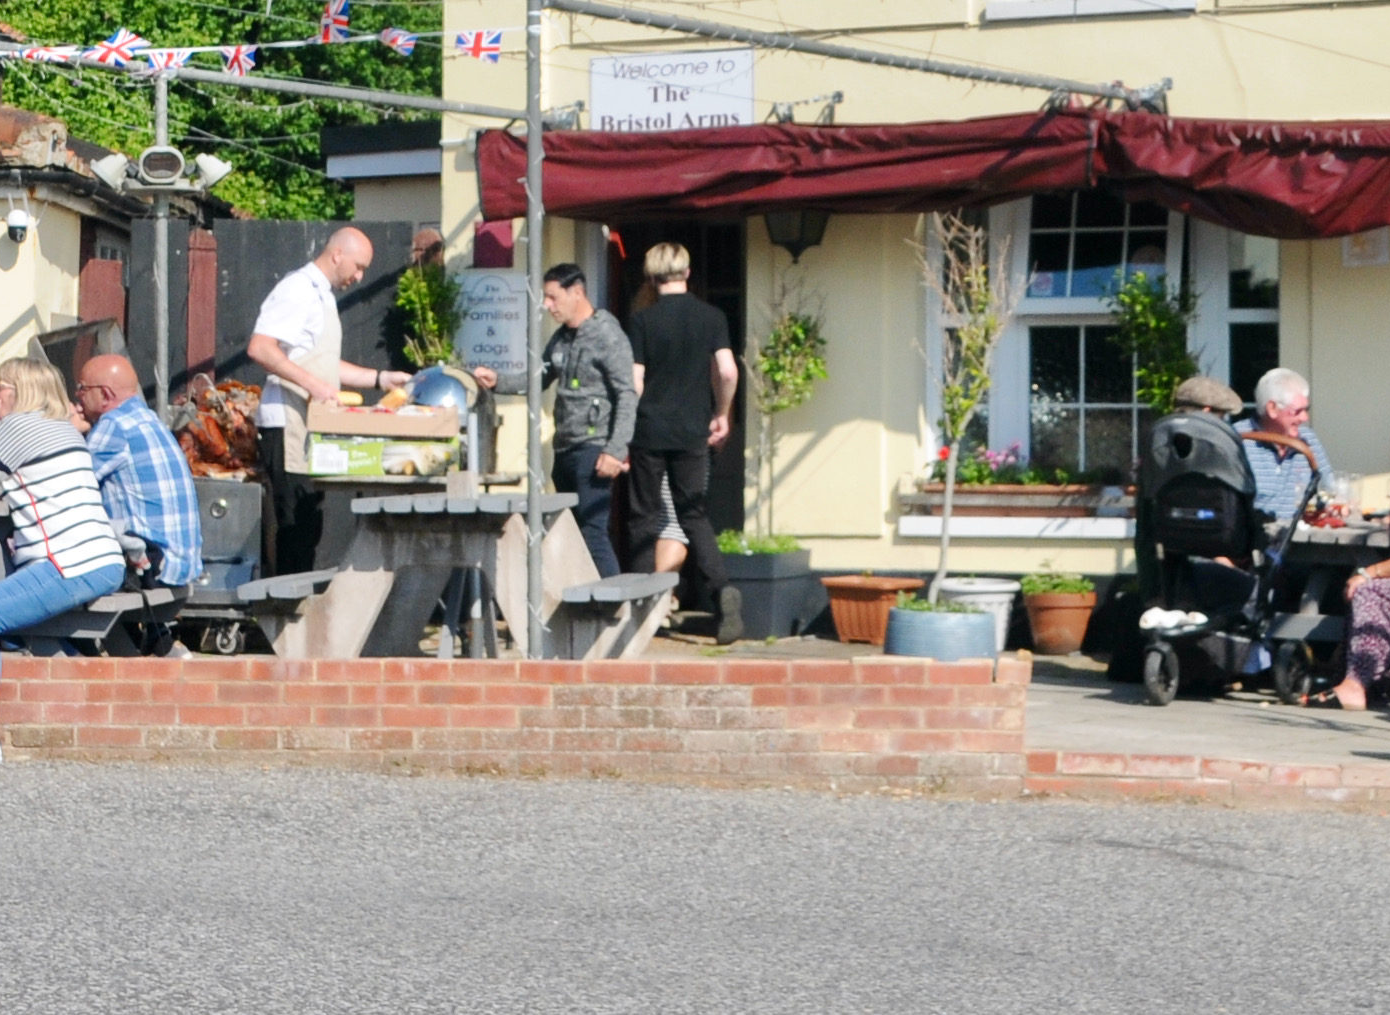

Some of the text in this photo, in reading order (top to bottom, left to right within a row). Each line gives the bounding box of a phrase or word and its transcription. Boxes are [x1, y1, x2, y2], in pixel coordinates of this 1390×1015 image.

[612, 57, 736, 80] Welcome to
[649, 85, 691, 103] The
[600, 111, 740, 132] Bristol Arms
[473, 342, 510, 356] dogs
